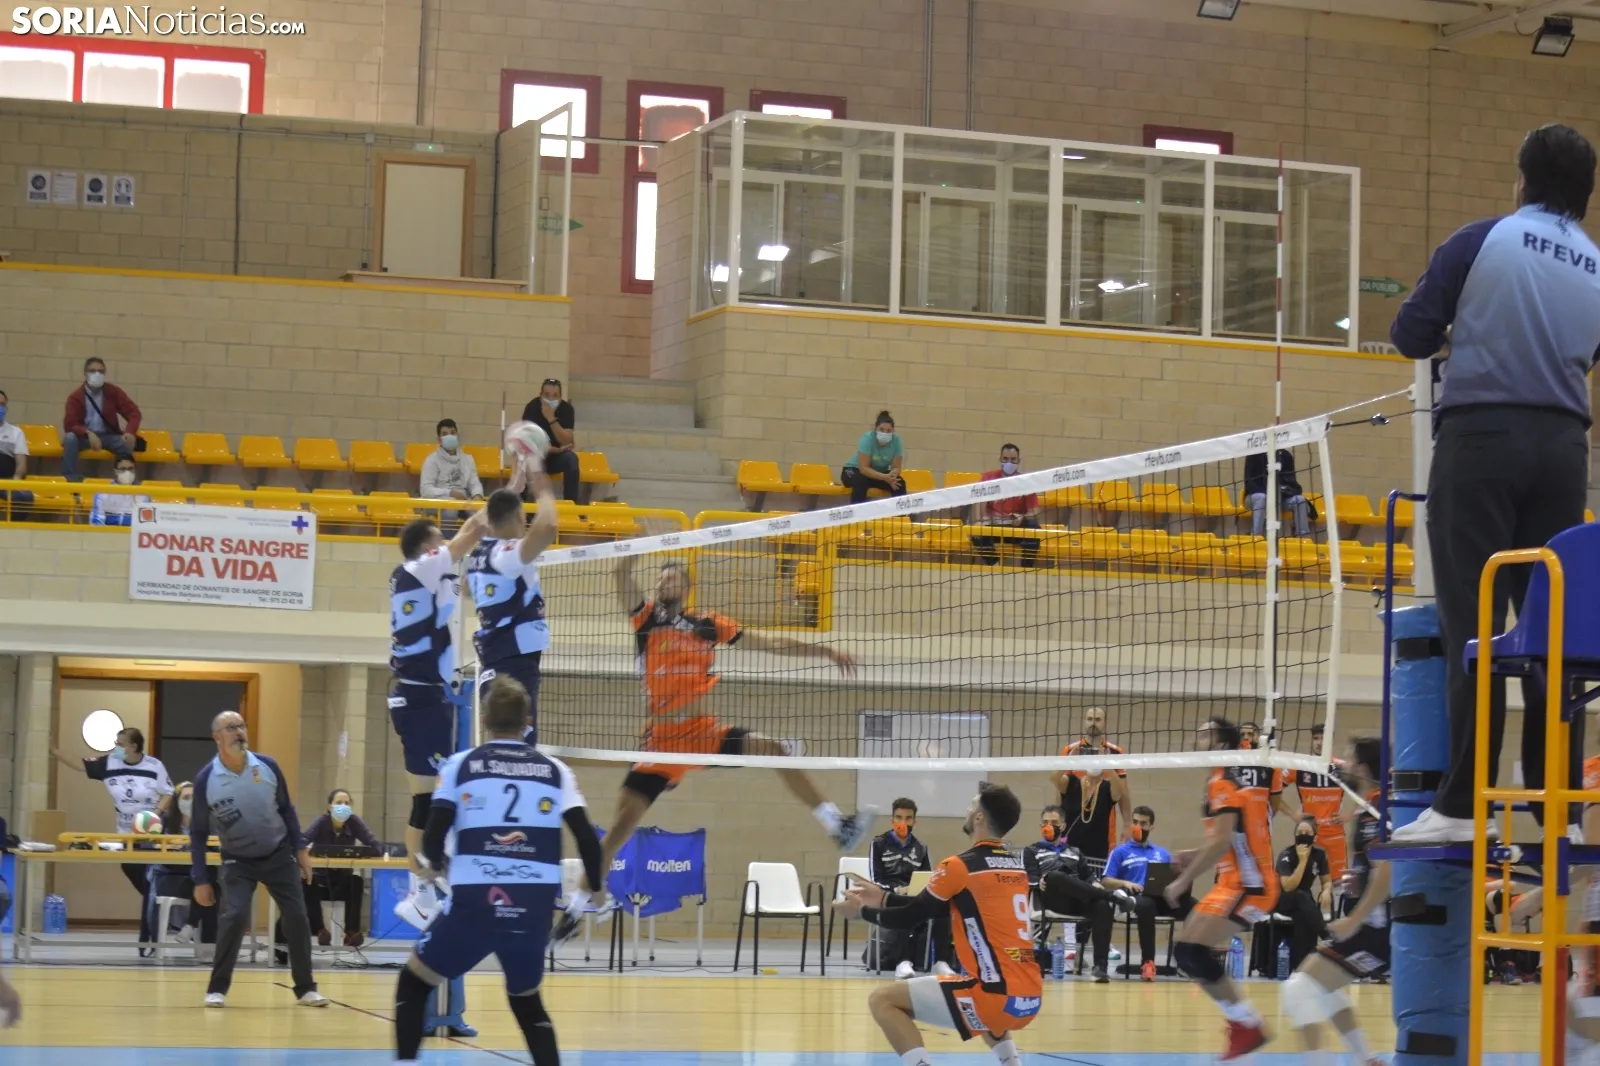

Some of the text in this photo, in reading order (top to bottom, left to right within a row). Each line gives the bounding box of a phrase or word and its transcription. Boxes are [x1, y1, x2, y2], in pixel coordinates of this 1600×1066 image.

[1522, 231, 1597, 275] RFEVB
[1144, 450, 1182, 468] rfevb.com
[138, 532, 309, 560] DONAR SANGRE
[166, 554, 278, 583] DA VIDA
[137, 581, 180, 590] HERMANDAD
[193, 584, 230, 593] DONANTES
[242, 588, 270, 596] SANGRE
[1241, 768, 1258, 786] 21
[503, 783, 520, 823] 2
[647, 859, 692, 872] molten
[1012, 893, 1031, 941] 9
